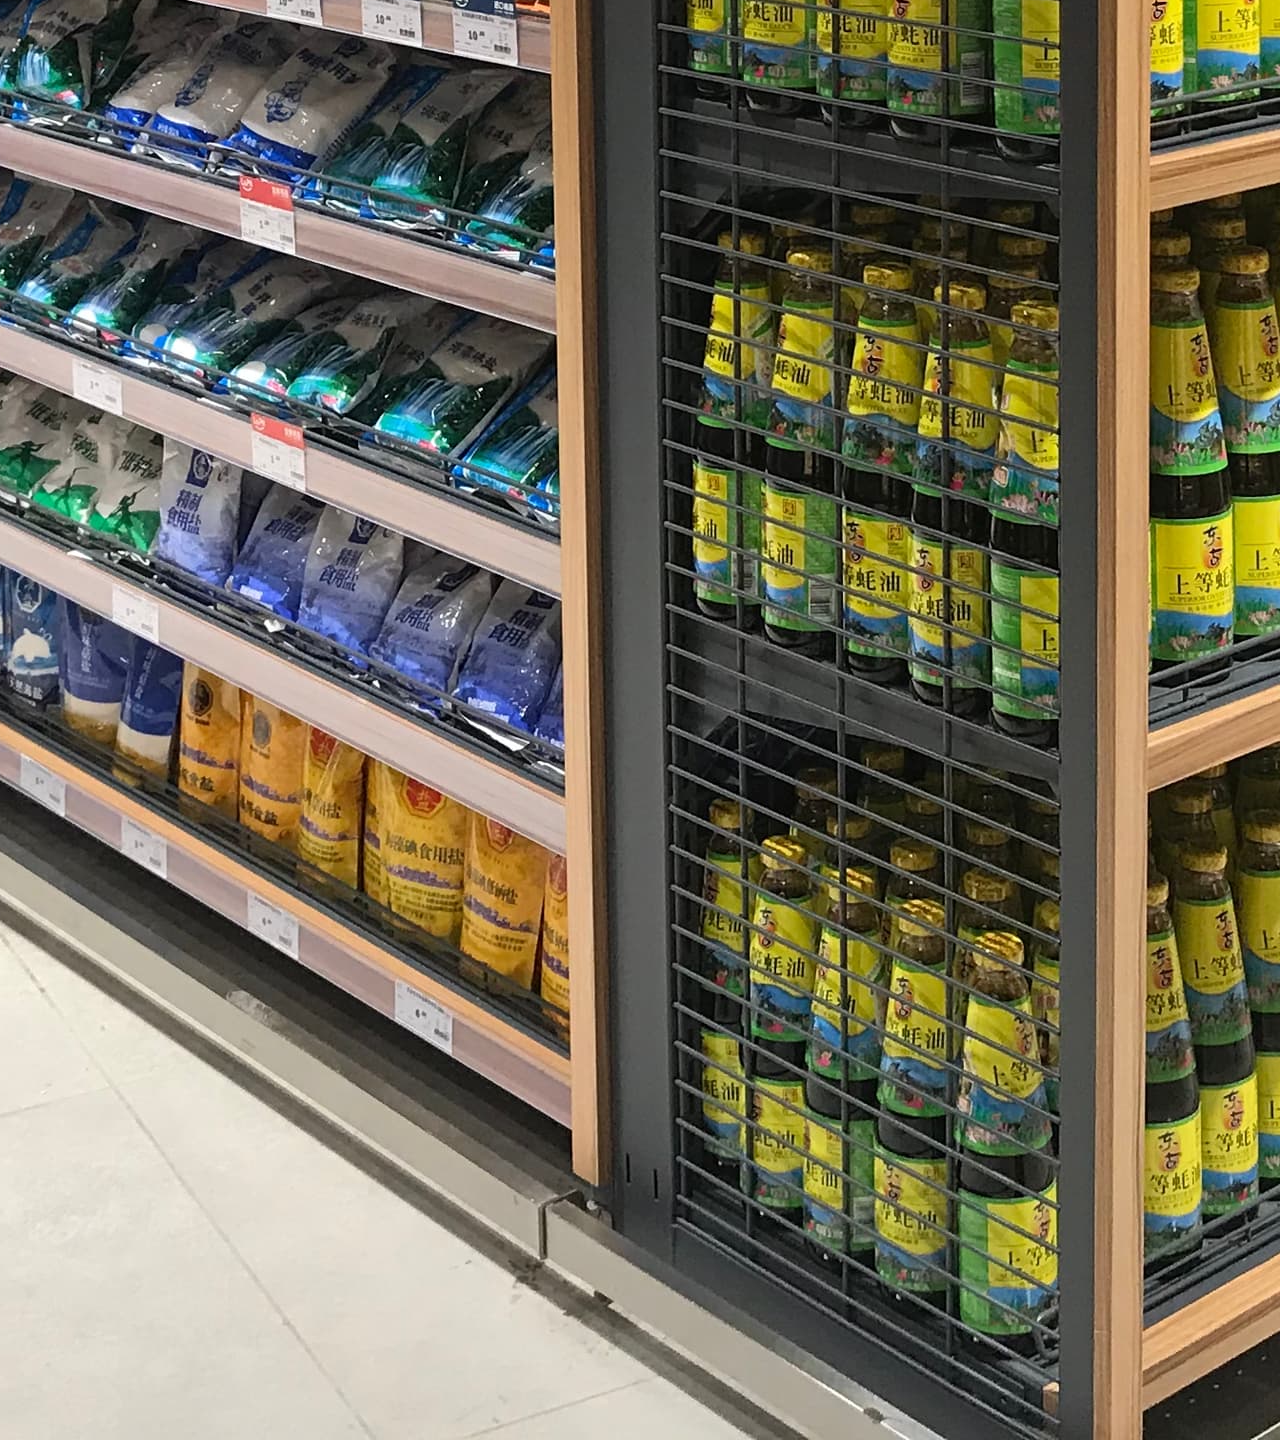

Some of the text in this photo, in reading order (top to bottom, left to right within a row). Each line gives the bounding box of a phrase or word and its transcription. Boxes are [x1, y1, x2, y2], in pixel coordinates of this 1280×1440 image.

[168, 508, 202, 535] 食用盐
[320, 564, 358, 592] 食用盐
